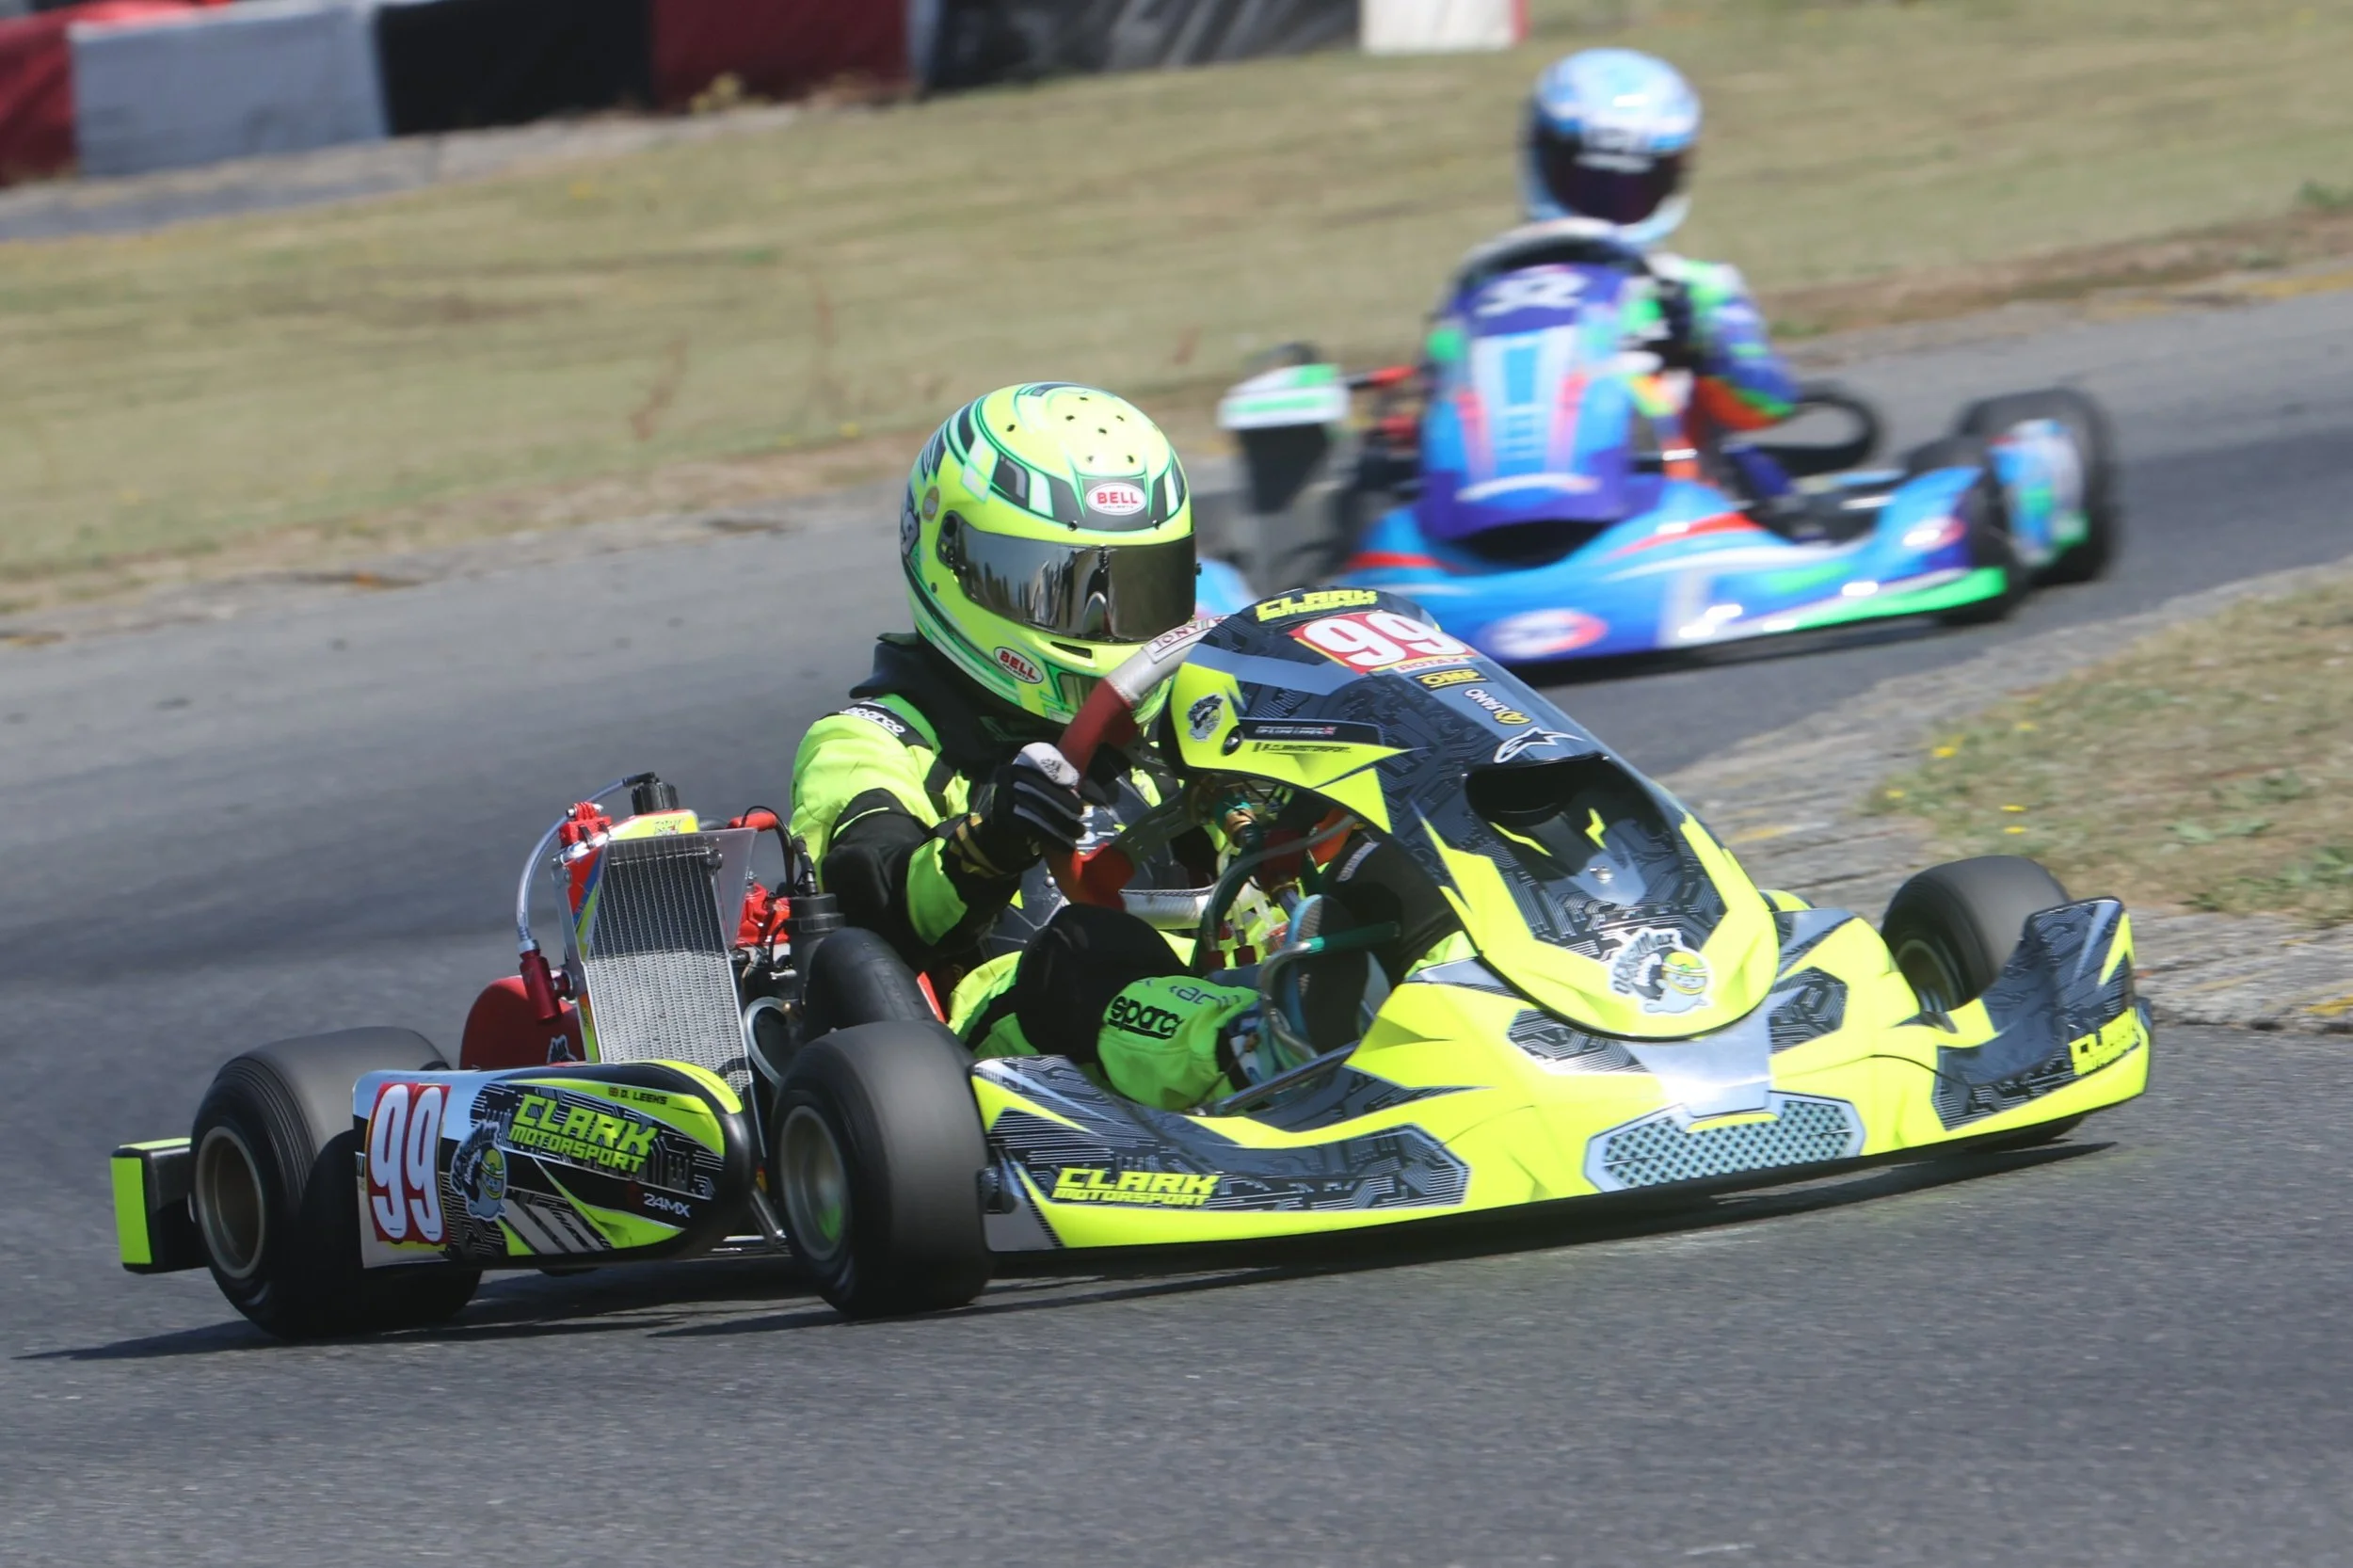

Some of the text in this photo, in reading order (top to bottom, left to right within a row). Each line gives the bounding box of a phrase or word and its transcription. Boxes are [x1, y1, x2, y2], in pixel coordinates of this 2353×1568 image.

[1096, 491, 1139, 504] BELL
[1255, 589, 1377, 616] CLARK
[1303, 611, 1466, 667] 99
[1000, 649, 1037, 680] BELL
[1399, 658, 1464, 671] ROTAX
[1421, 670, 1481, 685] OMP
[513, 1093, 659, 1158] CLARK
[370, 1083, 444, 1242] 99
[507, 1124, 648, 1174] MOTORSPORT
[1055, 1167, 1221, 1195] CLARK
[643, 1192, 691, 1219] 24MX
[1050, 1187, 1212, 1207] MOTORSPORT
